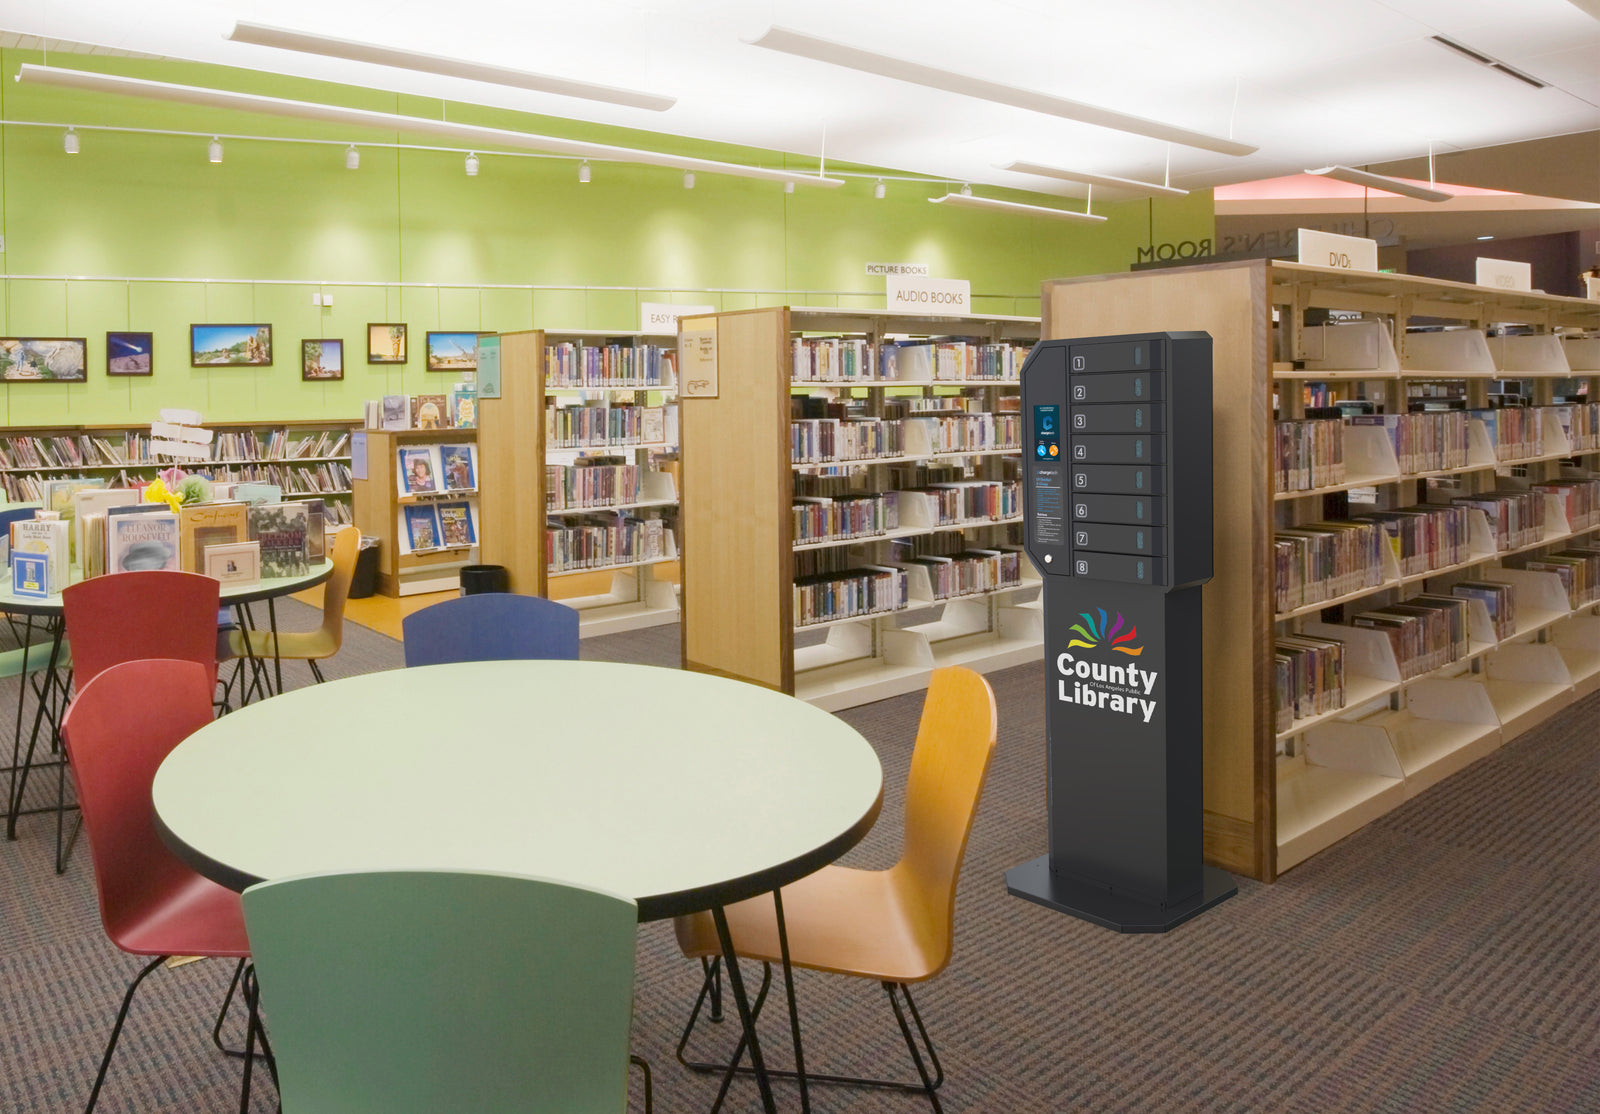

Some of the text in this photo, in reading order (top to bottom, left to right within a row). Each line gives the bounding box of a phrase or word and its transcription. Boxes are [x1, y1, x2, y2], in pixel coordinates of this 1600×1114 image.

[1329, 251, 1351, 269] DVDs
[867, 264, 928, 275] PICTURE BOOKS
[896, 289, 964, 305] AUDIO BOOKS
[650, 313, 671, 324] EASY
[22, 523, 51, 532] HARRY
[125, 523, 167, 533] ELEANOR
[122, 532, 170, 543] ROOSEVELT
[1056, 652, 1158, 695] County
[1105, 684, 1125, 693] Angeles
[1125, 687, 1141, 695] Public
[1058, 679, 1157, 724] Library
